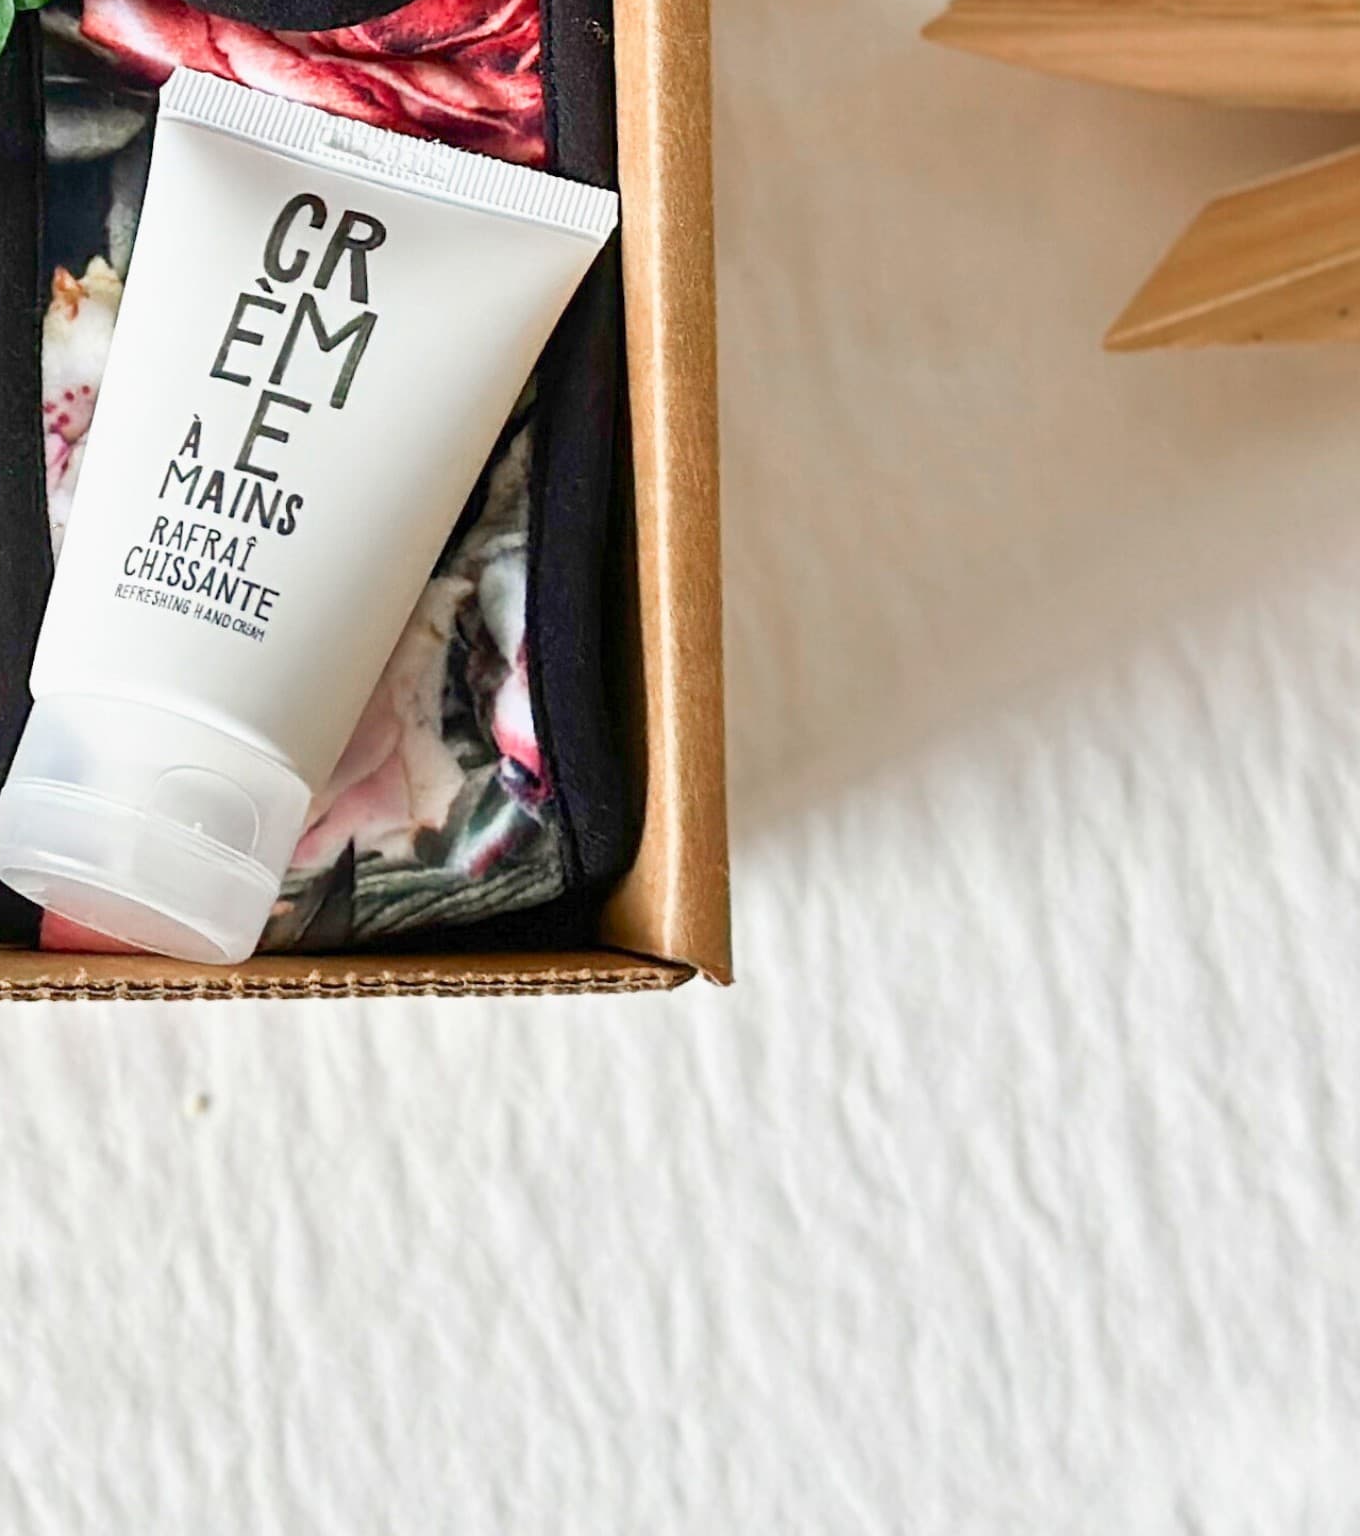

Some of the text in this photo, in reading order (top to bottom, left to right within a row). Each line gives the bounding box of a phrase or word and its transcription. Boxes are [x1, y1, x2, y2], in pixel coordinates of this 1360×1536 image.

[179, 412, 204, 458] À
[158, 459, 303, 536] MAINS
[149, 515, 258, 572] RAFRAÎ
[115, 583, 265, 642] REFRESHING HAND CREAM
[123, 546, 280, 622] CHISSANTE
